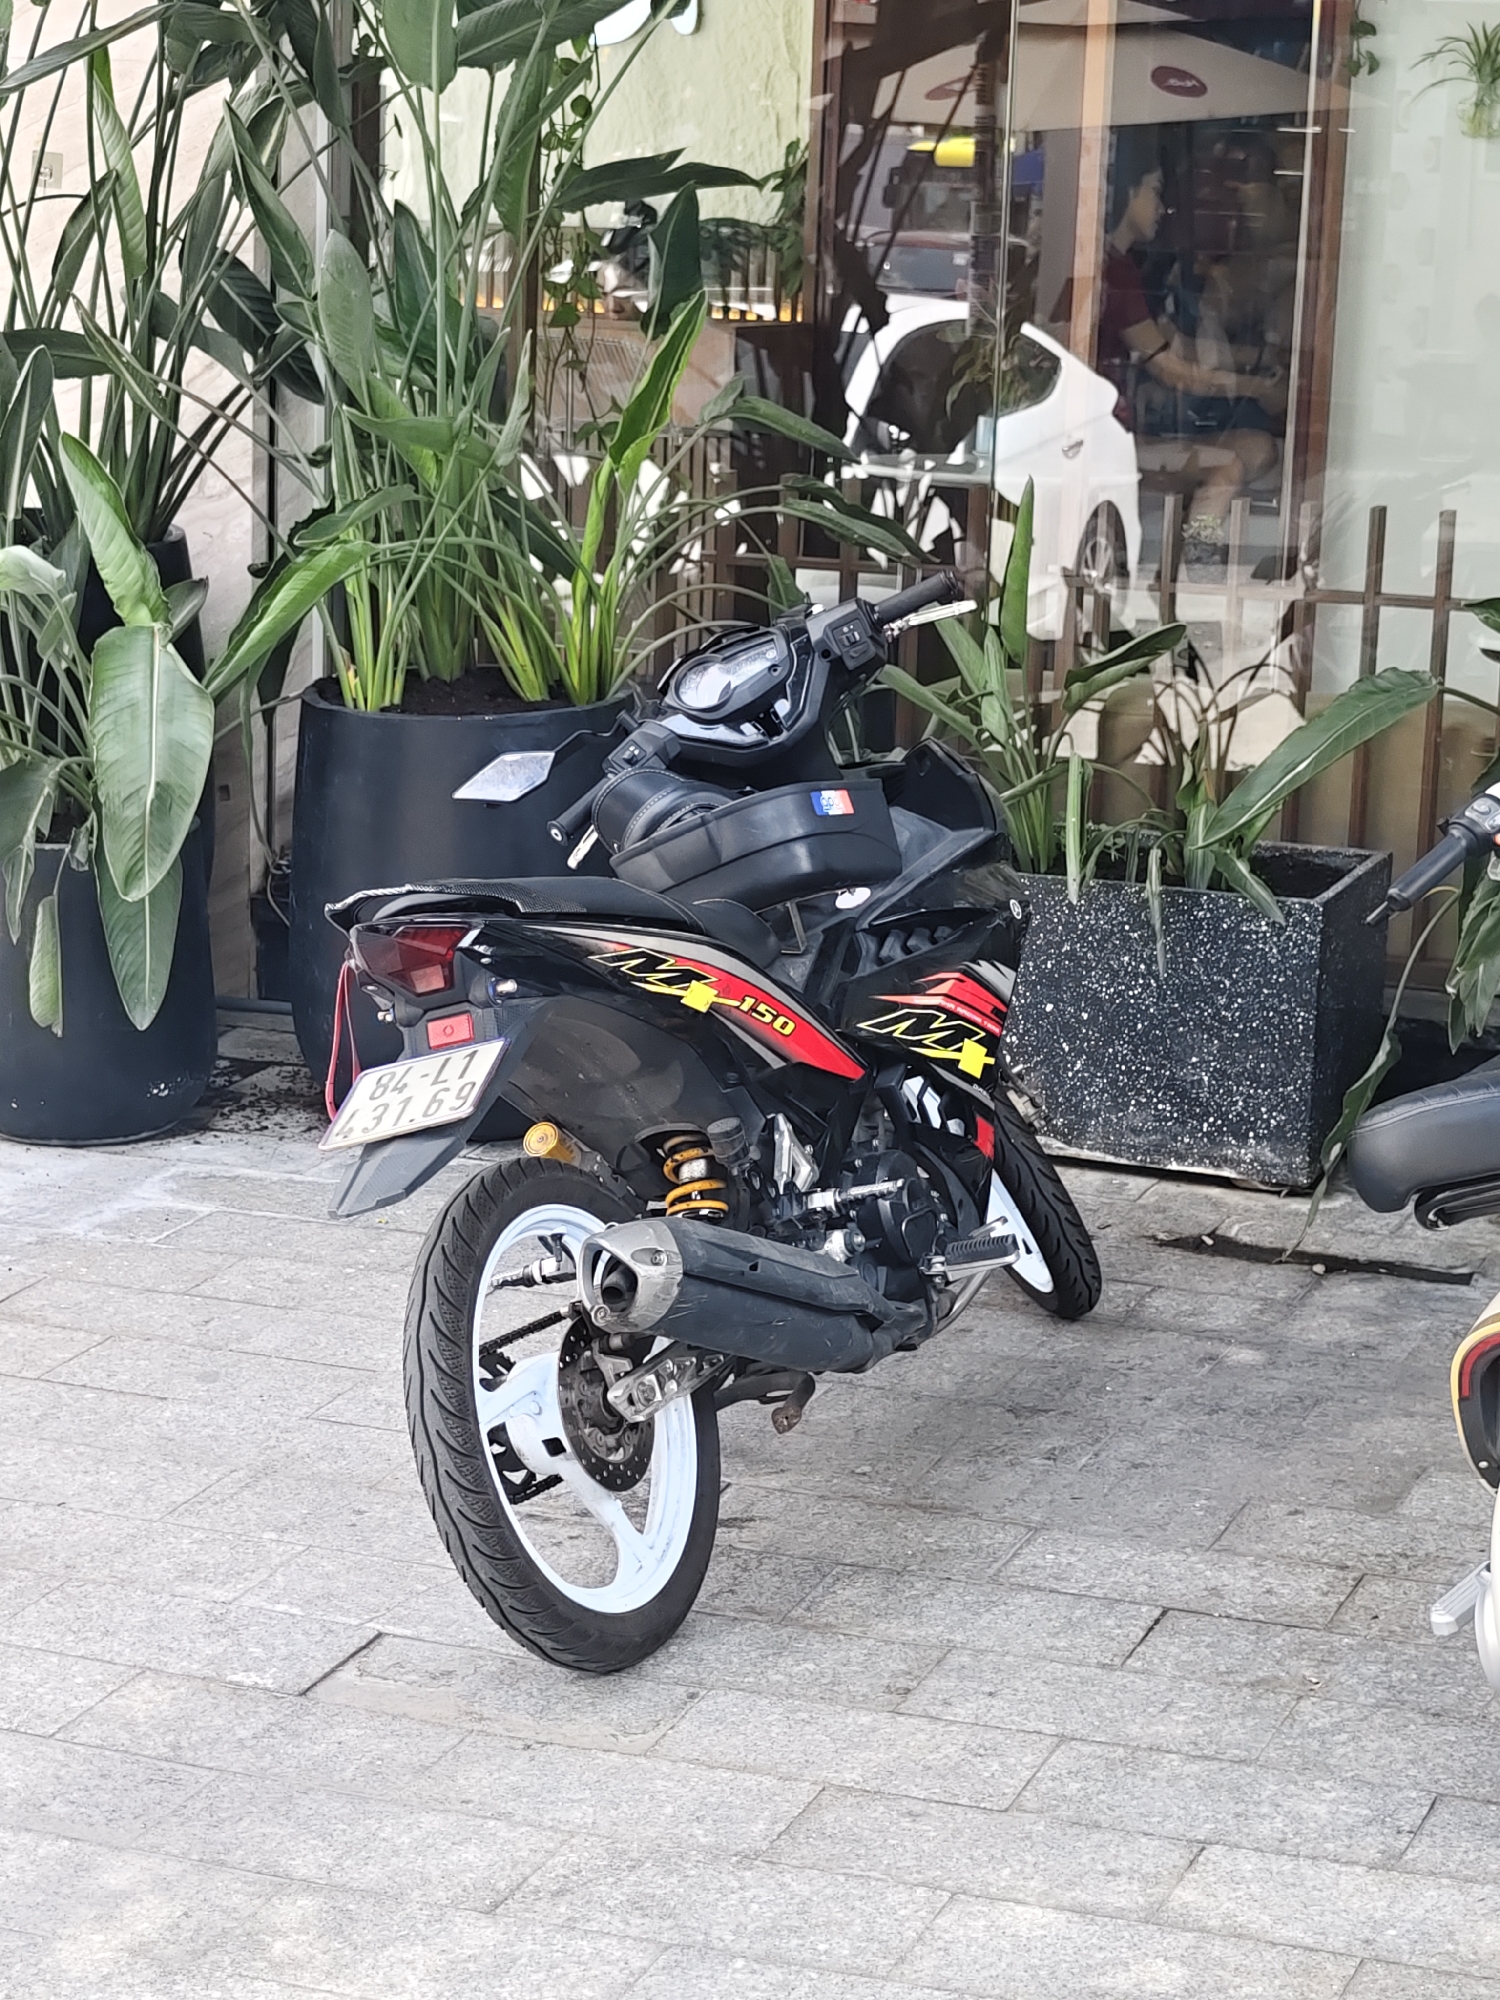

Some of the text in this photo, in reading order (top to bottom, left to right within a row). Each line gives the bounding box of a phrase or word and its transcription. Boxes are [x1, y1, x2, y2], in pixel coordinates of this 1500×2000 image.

[738, 995, 797, 1037] 150
[368, 1050, 480, 1101] 84-L1
[335, 1081, 477, 1138] 431.69
